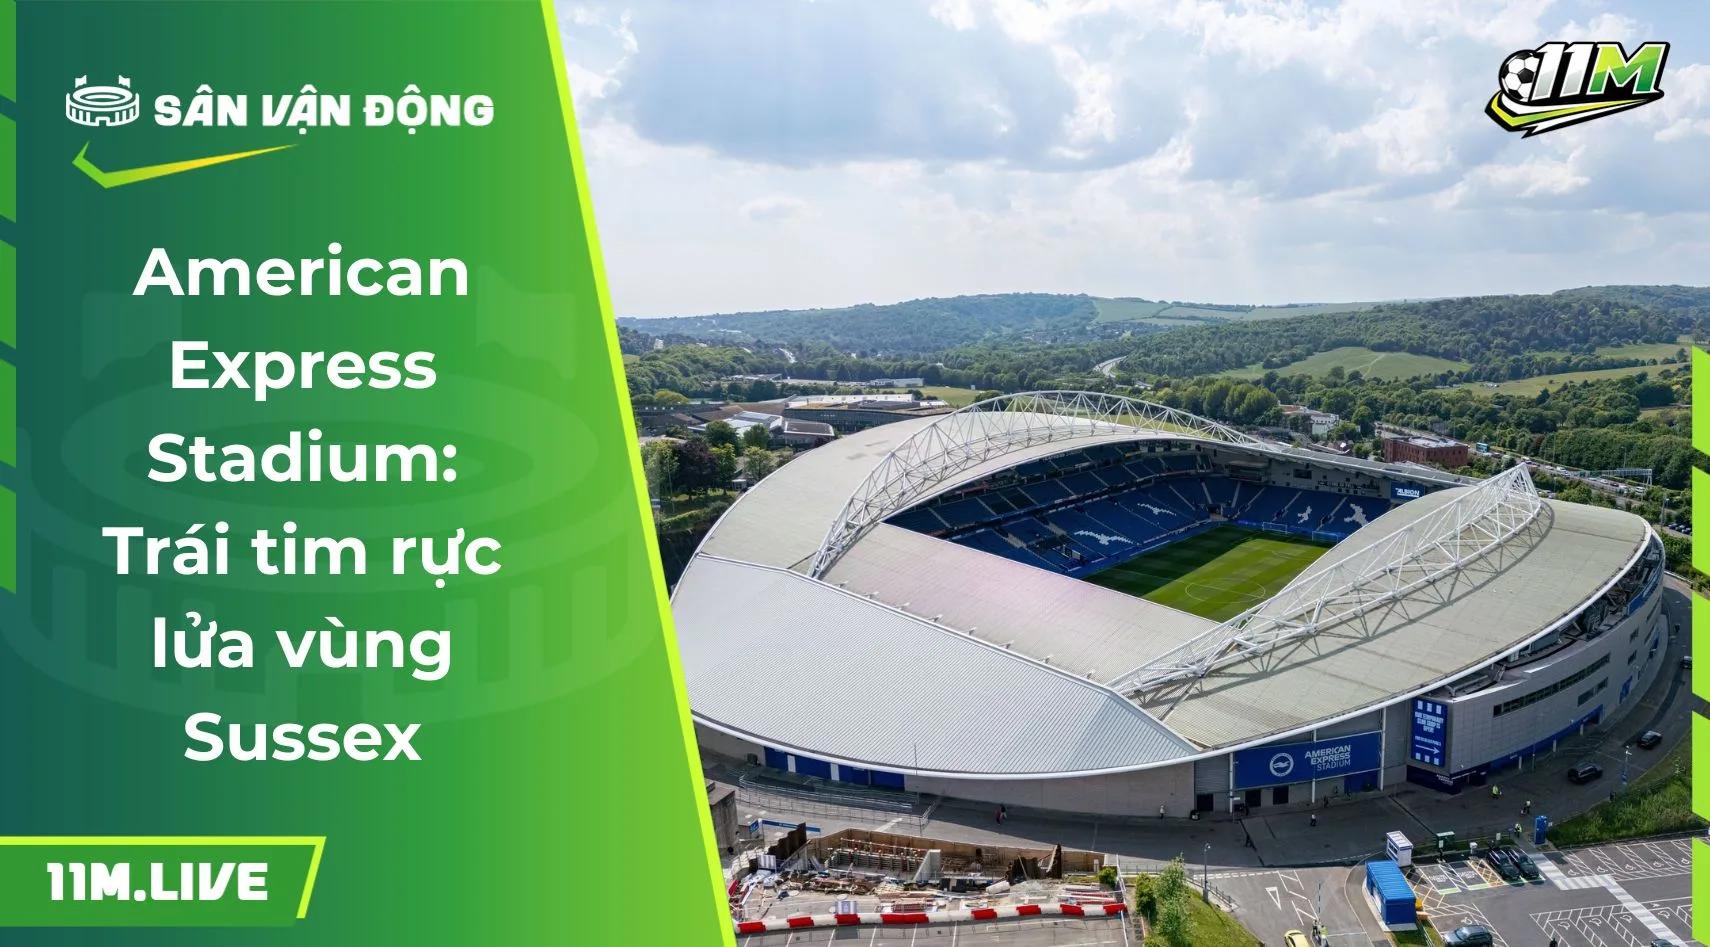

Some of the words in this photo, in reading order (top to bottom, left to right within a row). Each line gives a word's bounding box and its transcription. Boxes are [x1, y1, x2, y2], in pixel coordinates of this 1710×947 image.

[1305, 744, 1351, 759] AMERICAN
[1311, 752, 1351, 765] EXPRESS
[1317, 759, 1351, 771] STADIUM
